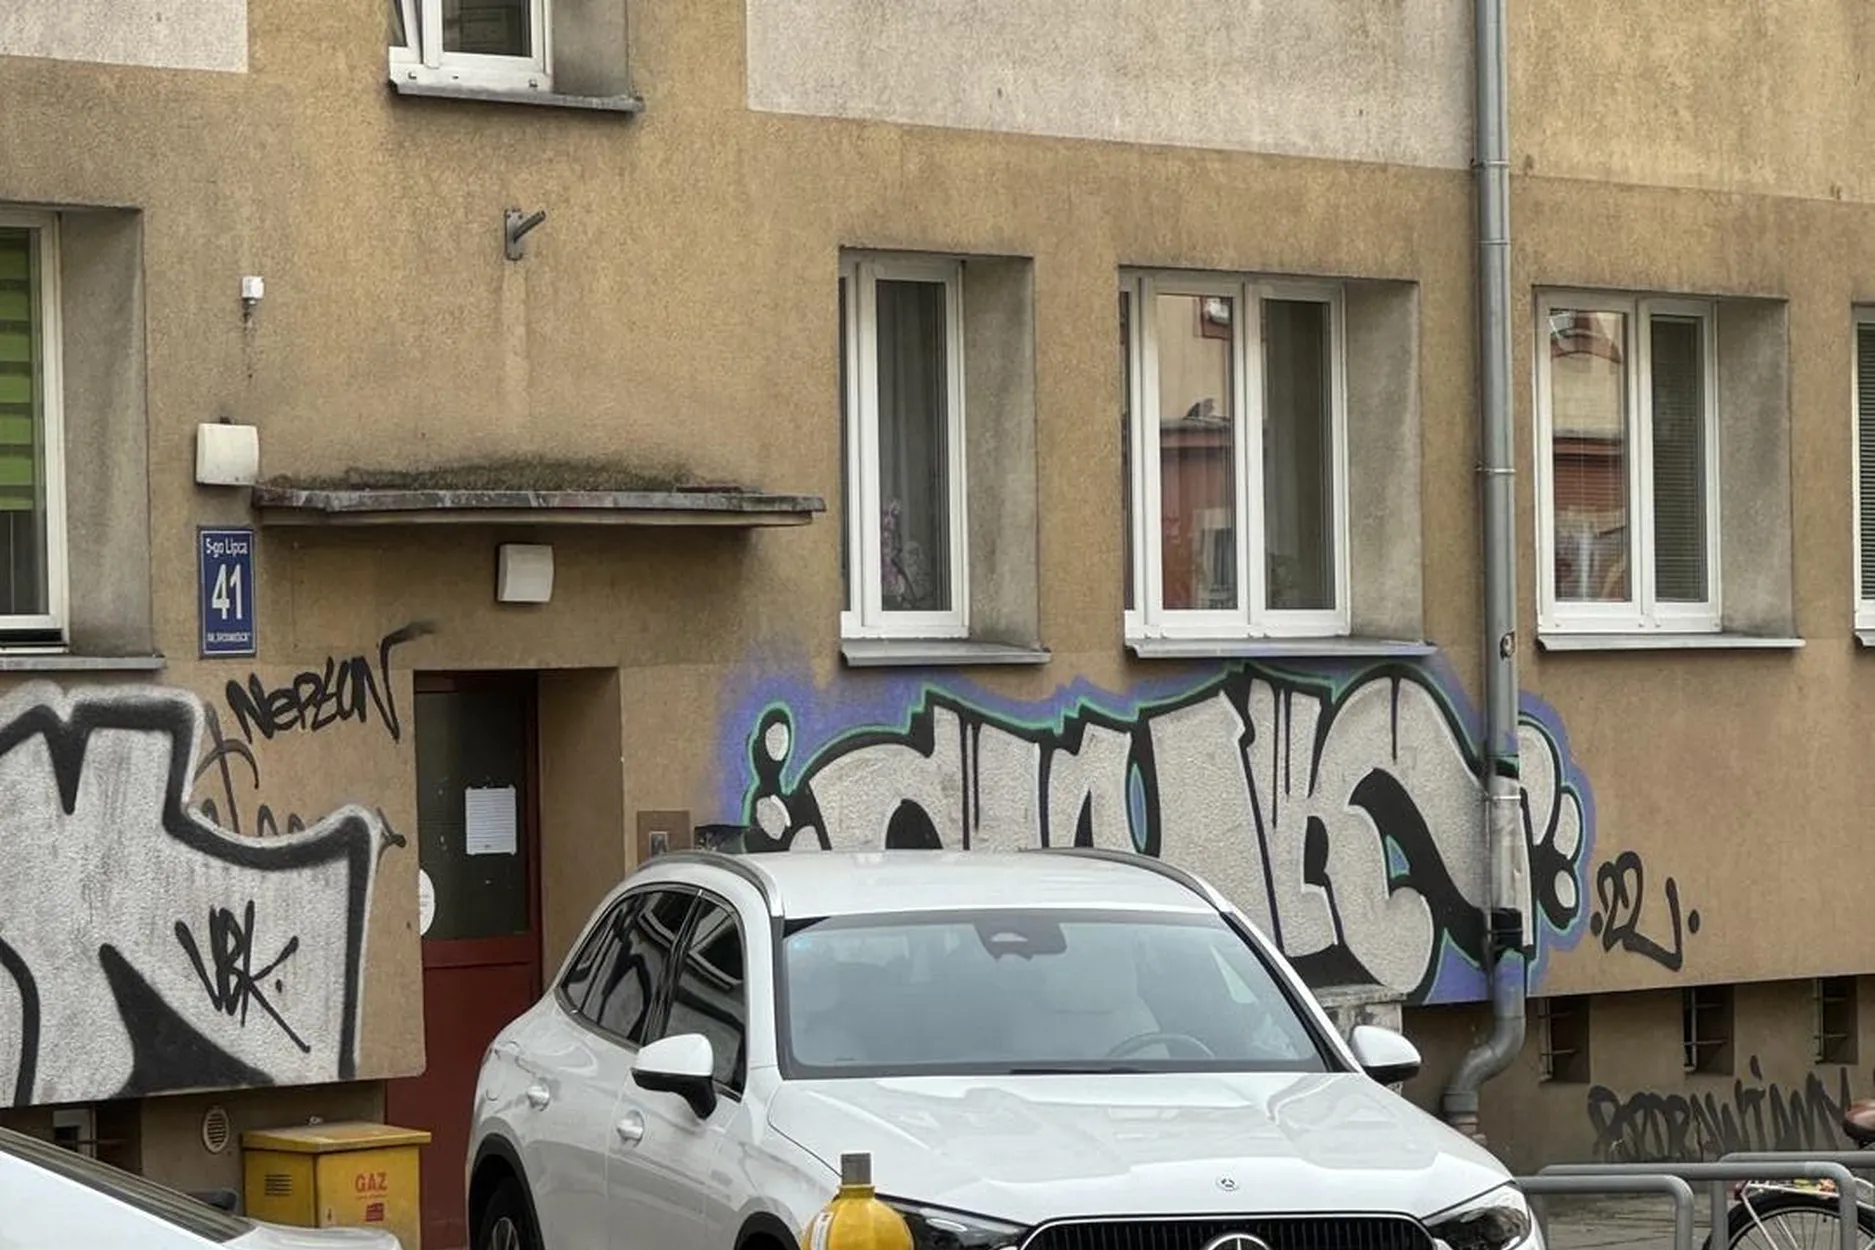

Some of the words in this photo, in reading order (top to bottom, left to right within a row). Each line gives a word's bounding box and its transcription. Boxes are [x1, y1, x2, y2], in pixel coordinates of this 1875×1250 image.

[225, 537, 248, 557] Lipca
[211, 563, 243, 620] 41
[354, 1171, 388, 1194] GAZ
